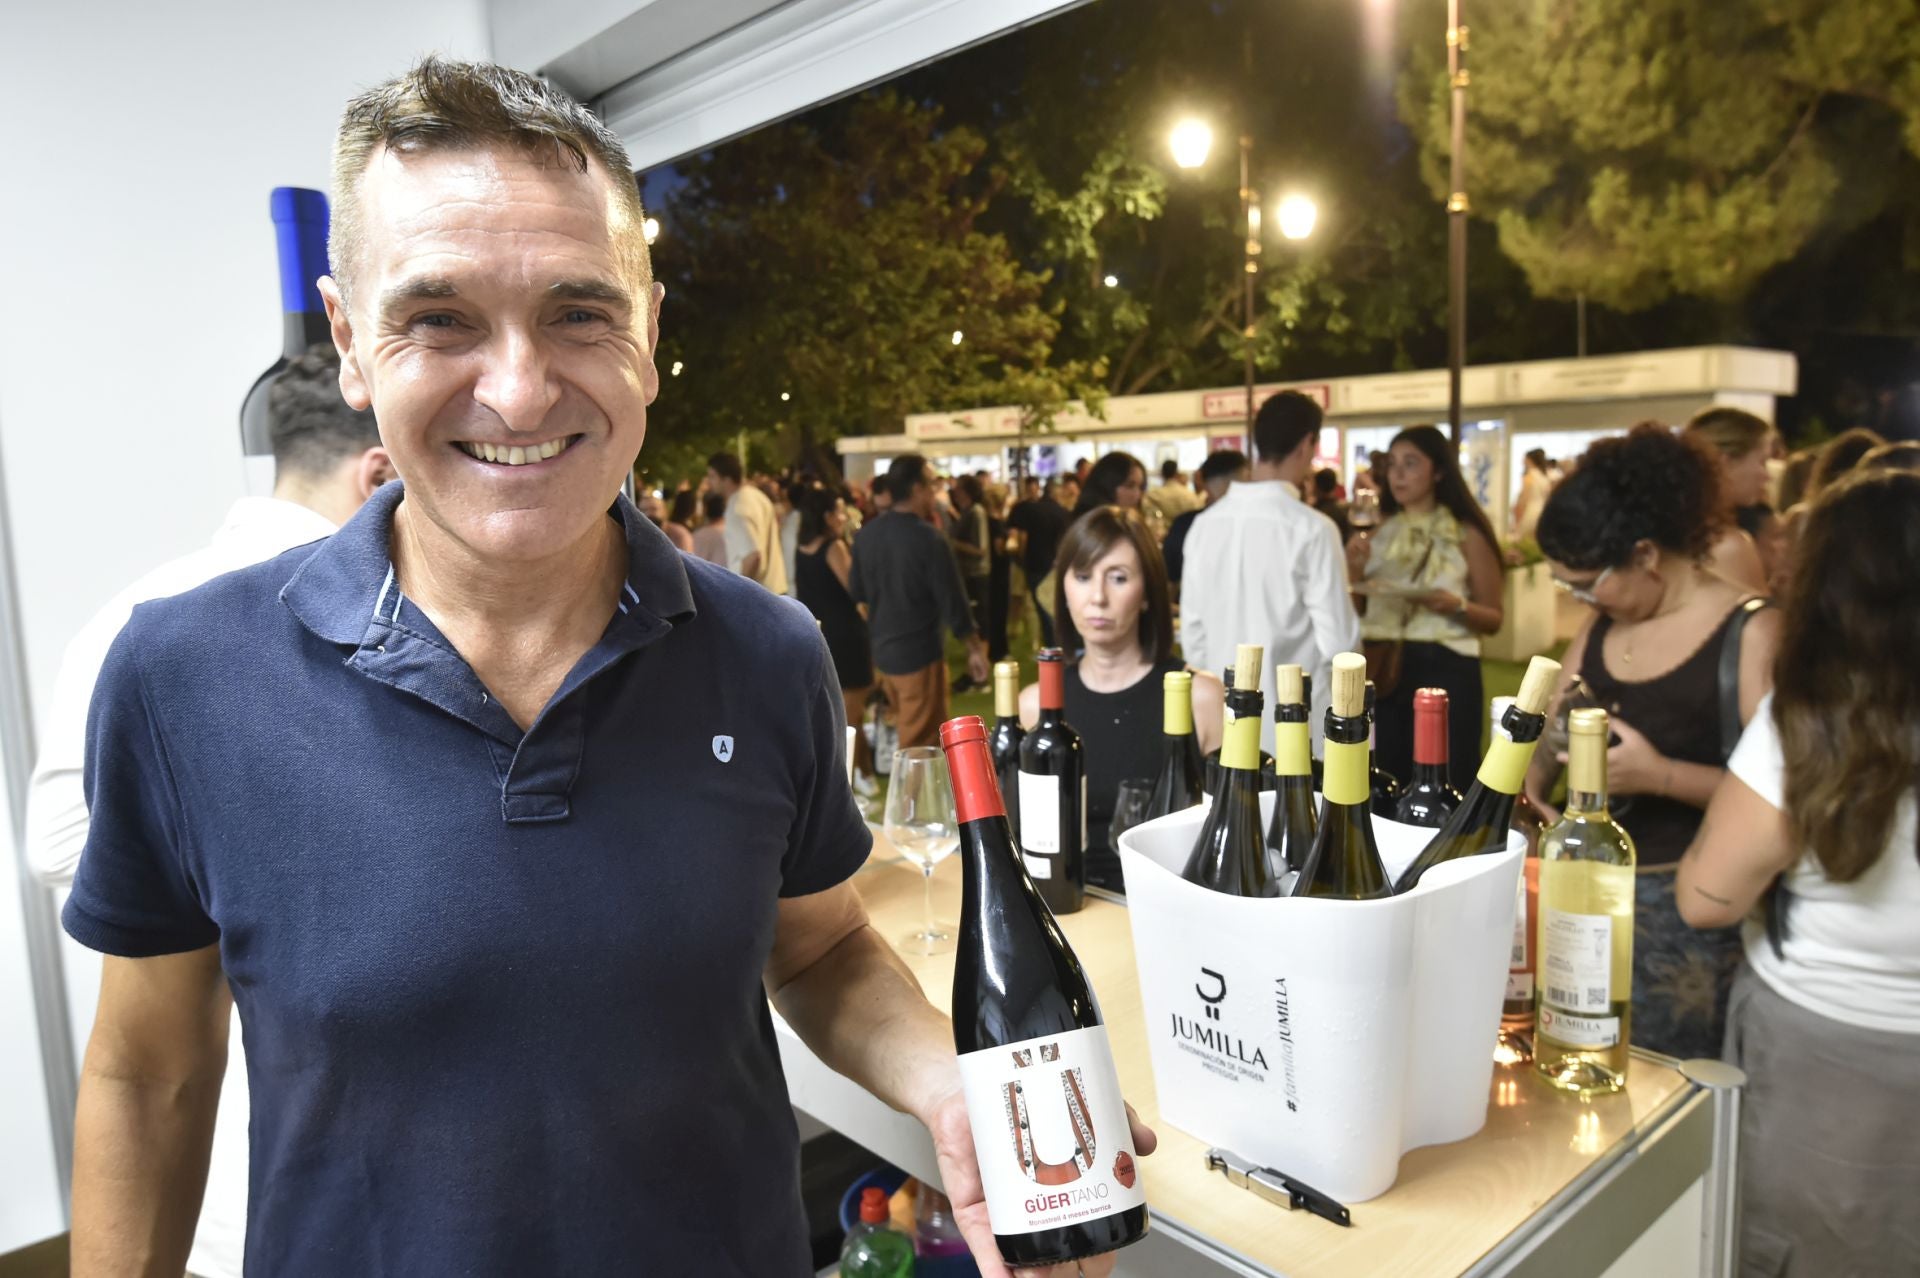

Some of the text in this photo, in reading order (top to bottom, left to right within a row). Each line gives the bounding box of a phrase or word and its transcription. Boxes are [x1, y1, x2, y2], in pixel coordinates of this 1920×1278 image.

[719, 740, 728, 754] A
[1171, 1013, 1269, 1071] JUMILLA
[1025, 1182, 1109, 1213] GÜERTANO
[1028, 1214, 1062, 1226] Monastrell
[1068, 1209, 1090, 1219] meses
[1090, 1203, 1112, 1214] barrica
